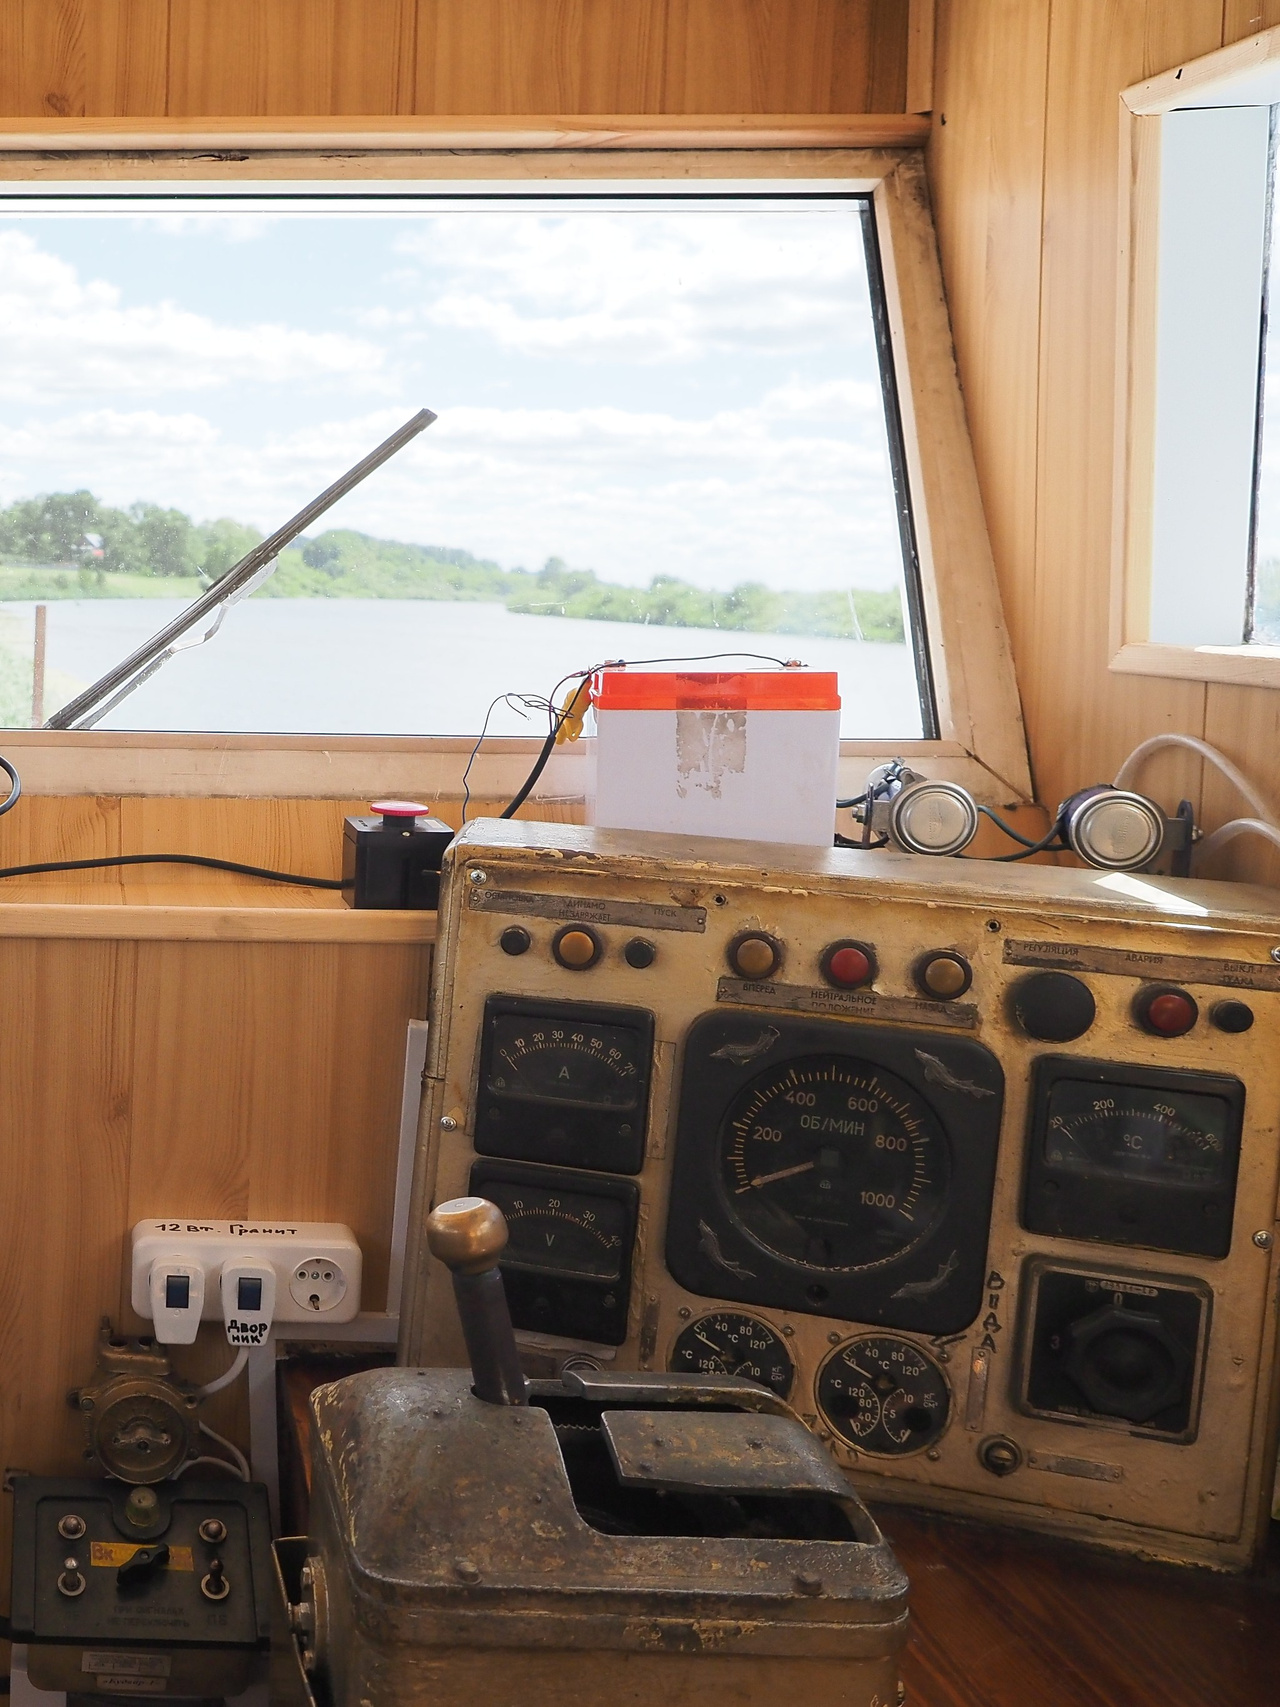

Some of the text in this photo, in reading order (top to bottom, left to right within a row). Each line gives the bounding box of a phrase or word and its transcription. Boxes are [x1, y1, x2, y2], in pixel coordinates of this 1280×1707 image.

[566, 901, 606, 911] ДИНАМО
[653, 908, 678, 918] ПУСК
[1023, 943, 1079, 956] РЕГУЛЯЦИЯ
[1124, 953, 1164, 965] АВАРИЯ
[742, 983, 777, 995] ВПЕРЕД
[811, 990, 878, 1005] НЕЙТРАЛЬНОЕ
[499, 1030, 637, 1075] 0 10 20 30 40 50 60 70
[558, 1065, 570, 1080] A
[785, 1090, 879, 1113] 400 600
[1092, 1098, 1176, 1118] 200 400
[799, 1114, 866, 1136] ОБ/МИН
[1049, 1115, 1064, 1129] 20
[752, 1125, 908, 1152] 200 800
[859, 1191, 896, 1209] 1000
[513, 1198, 623, 1247] 10 20 30 40
[155, 1223, 181, 1232] 12
[229, 1224, 298, 1236] Гранит
[545, 1232, 556, 1247] V
[715, 1322, 753, 1336] 40 80
[749, 1339, 766, 1350] 120
[1050, 1335, 1060, 1350] 3
[864, 1347, 905, 1362] 40 80
[698, 1358, 715, 1370] 120
[902, 1365, 920, 1376] 120
[750, 1367, 761, 1376] 10
[848, 1387, 865, 1397] 120
[903, 1394, 914, 1403] 10
[858, 1398, 872, 1408] 80
[857, 1412, 872, 1422] 40
[889, 1409, 897, 1419] 5
